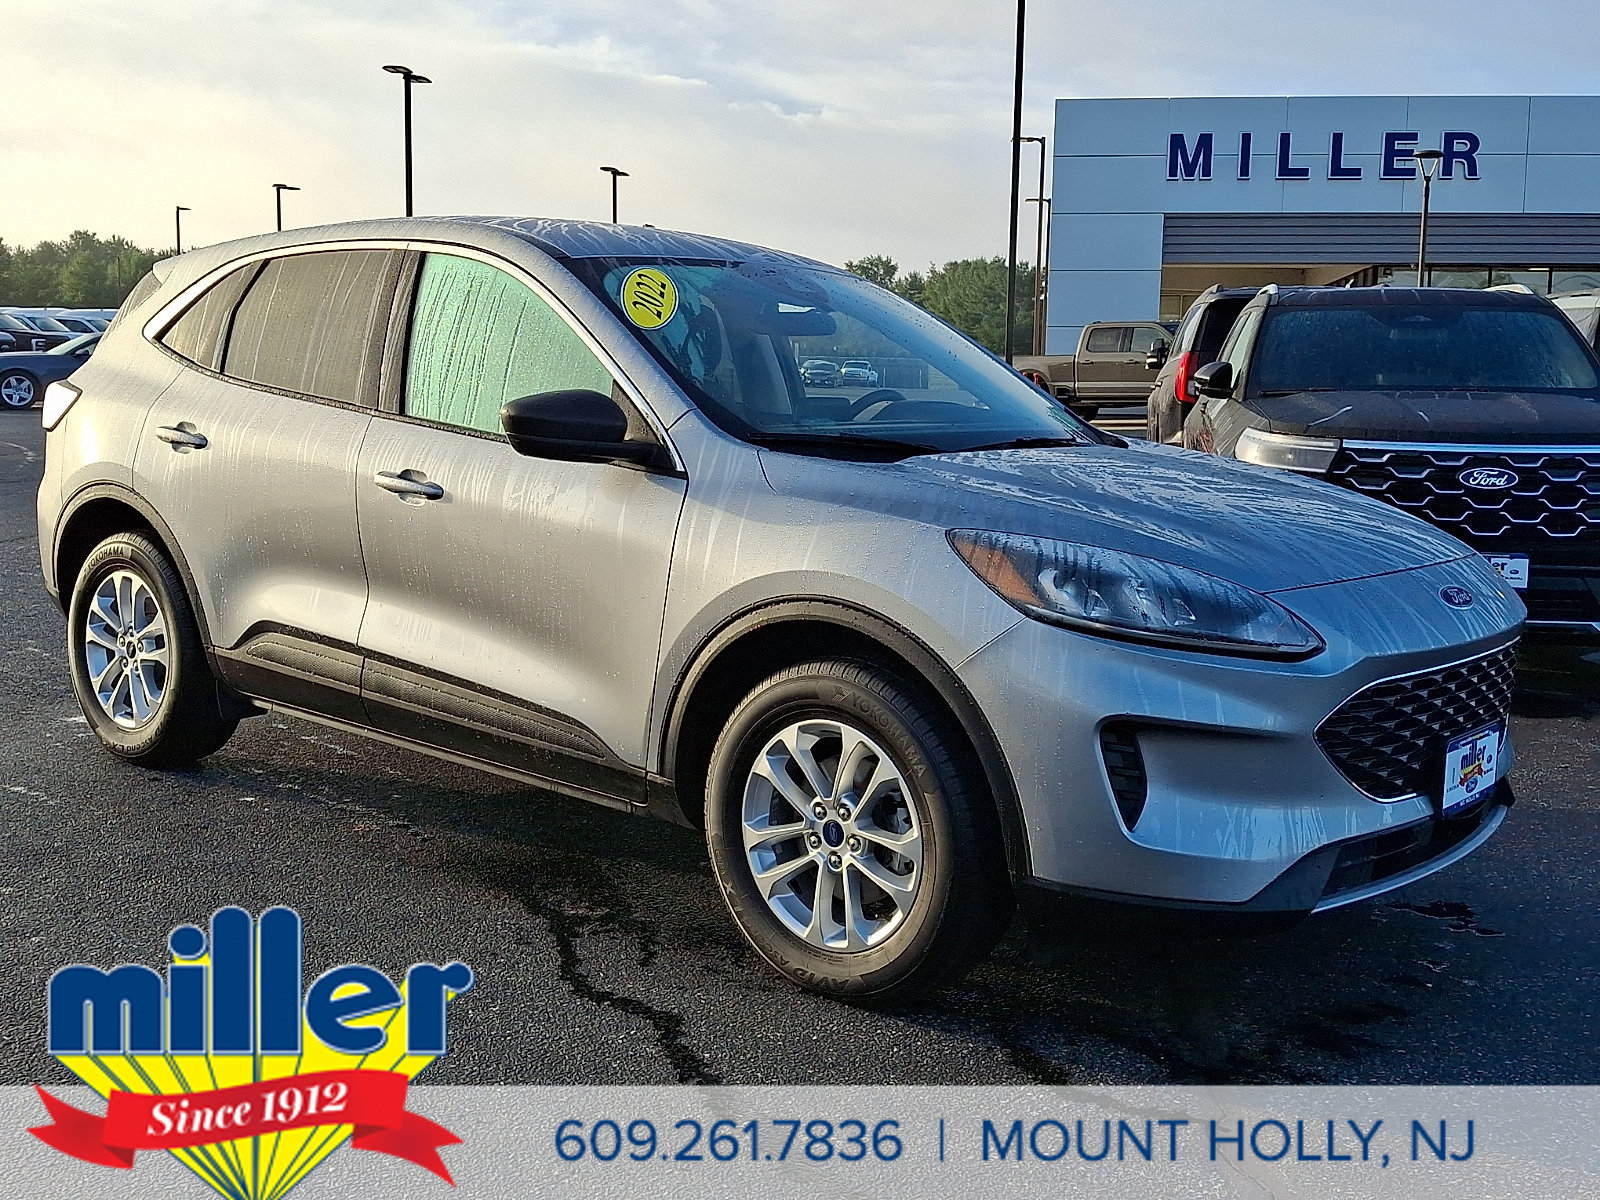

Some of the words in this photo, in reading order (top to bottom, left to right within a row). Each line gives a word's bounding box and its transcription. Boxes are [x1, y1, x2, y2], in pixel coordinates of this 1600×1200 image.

[1167, 131, 1481, 181] MILLER
[631, 273, 667, 321] 2022
[1469, 470, 1508, 487] Ford
[88, 546, 124, 570] YOKOHAMA
[850, 691, 927, 777] YOKOHAMA
[1460, 740, 1487, 772] miller
